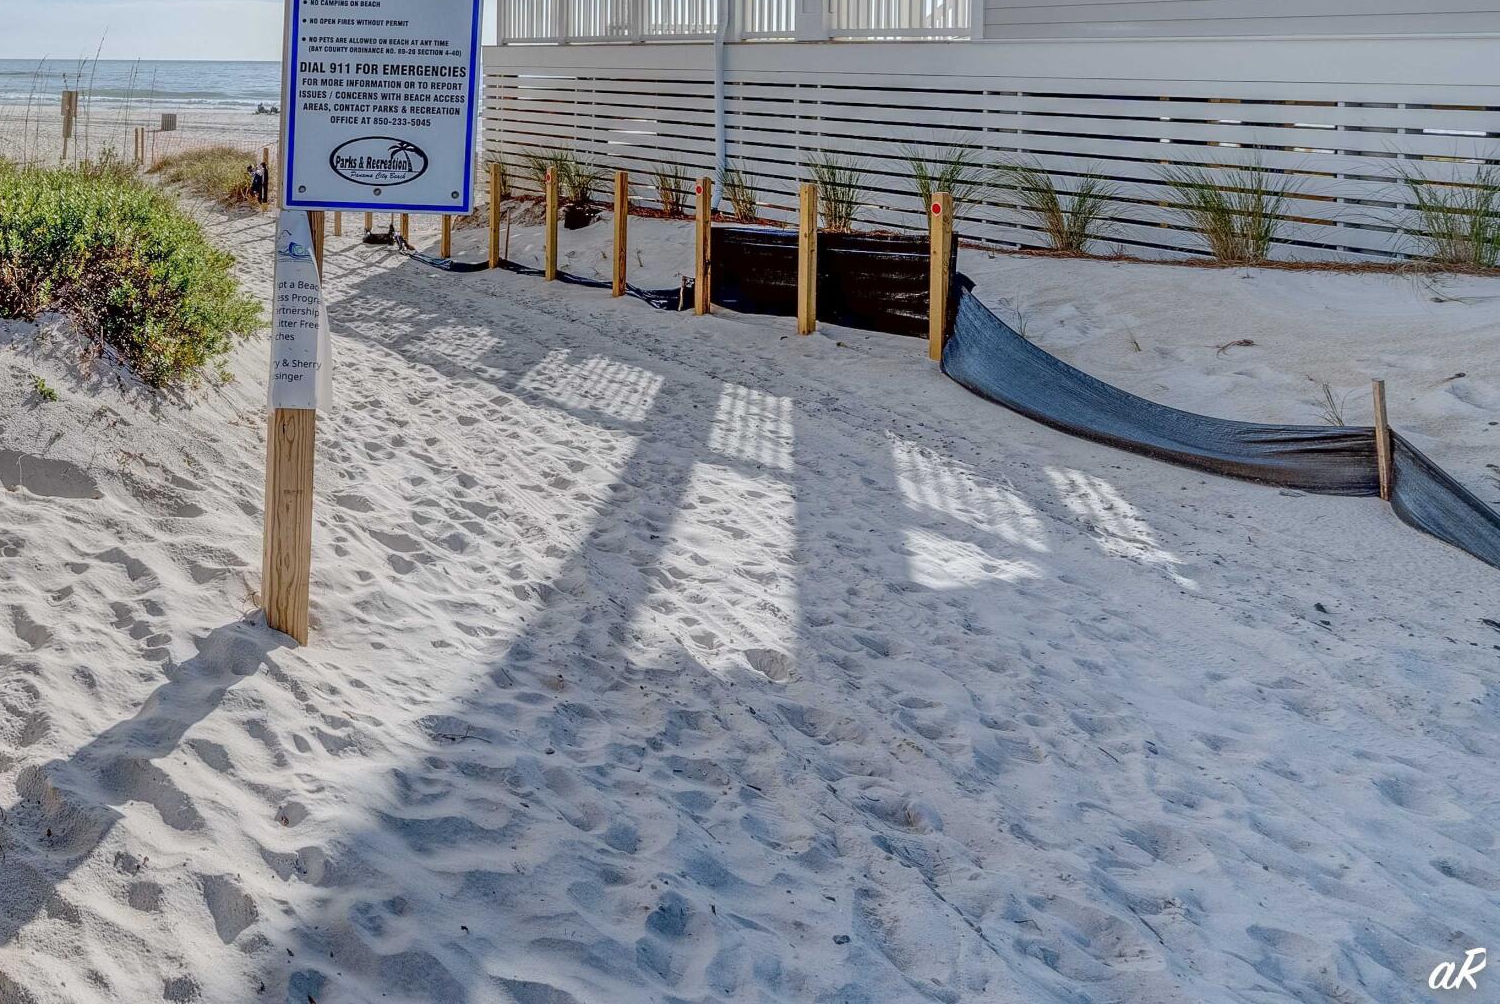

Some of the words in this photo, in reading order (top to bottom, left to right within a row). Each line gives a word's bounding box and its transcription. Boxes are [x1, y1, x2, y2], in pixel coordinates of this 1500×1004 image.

[348, 37, 377, 45] ALLOWED
[299, 62, 325, 74] DIAL
[329, 62, 350, 74] 911
[355, 63, 378, 75] FOR
[382, 64, 467, 78] EMERGENCIES
[302, 78, 318, 86] FOR
[320, 79, 343, 87] MORE
[346, 79, 401, 89] INFORMATION
[403, 81, 415, 89] OR
[417, 81, 428, 90] TO
[430, 81, 463, 91] REPORT
[298, 90, 327, 99] ISSUES
[335, 91, 378, 101] CONCERNS
[380, 93, 401, 101] WITH
[403, 93, 431, 102] BEACH
[432, 94, 466, 103] ACCESS
[302, 103, 331, 112] AREAS,
[333, 104, 370, 113] CONTACT
[372, 105, 398, 114] PARKS
[400, 105, 407, 114] &
[409, 105, 461, 115] RECREATION
[329, 116, 358, 125] OFFICE
[360, 117, 371, 125] AT
[373, 117, 432, 127] 850-233-5045
[334, 155, 357, 170] Parks
[358, 156, 365, 169] &
[366, 155, 407, 171] Recreation
[350, 171, 373, 179] Panama
[375, 171, 387, 180] City
[389, 172, 406, 180] Beach
[276, 319, 298, 328] itter
[299, 320, 320, 330] Free
[282, 358, 290, 368] &
[291, 359, 322, 371] Sherry
